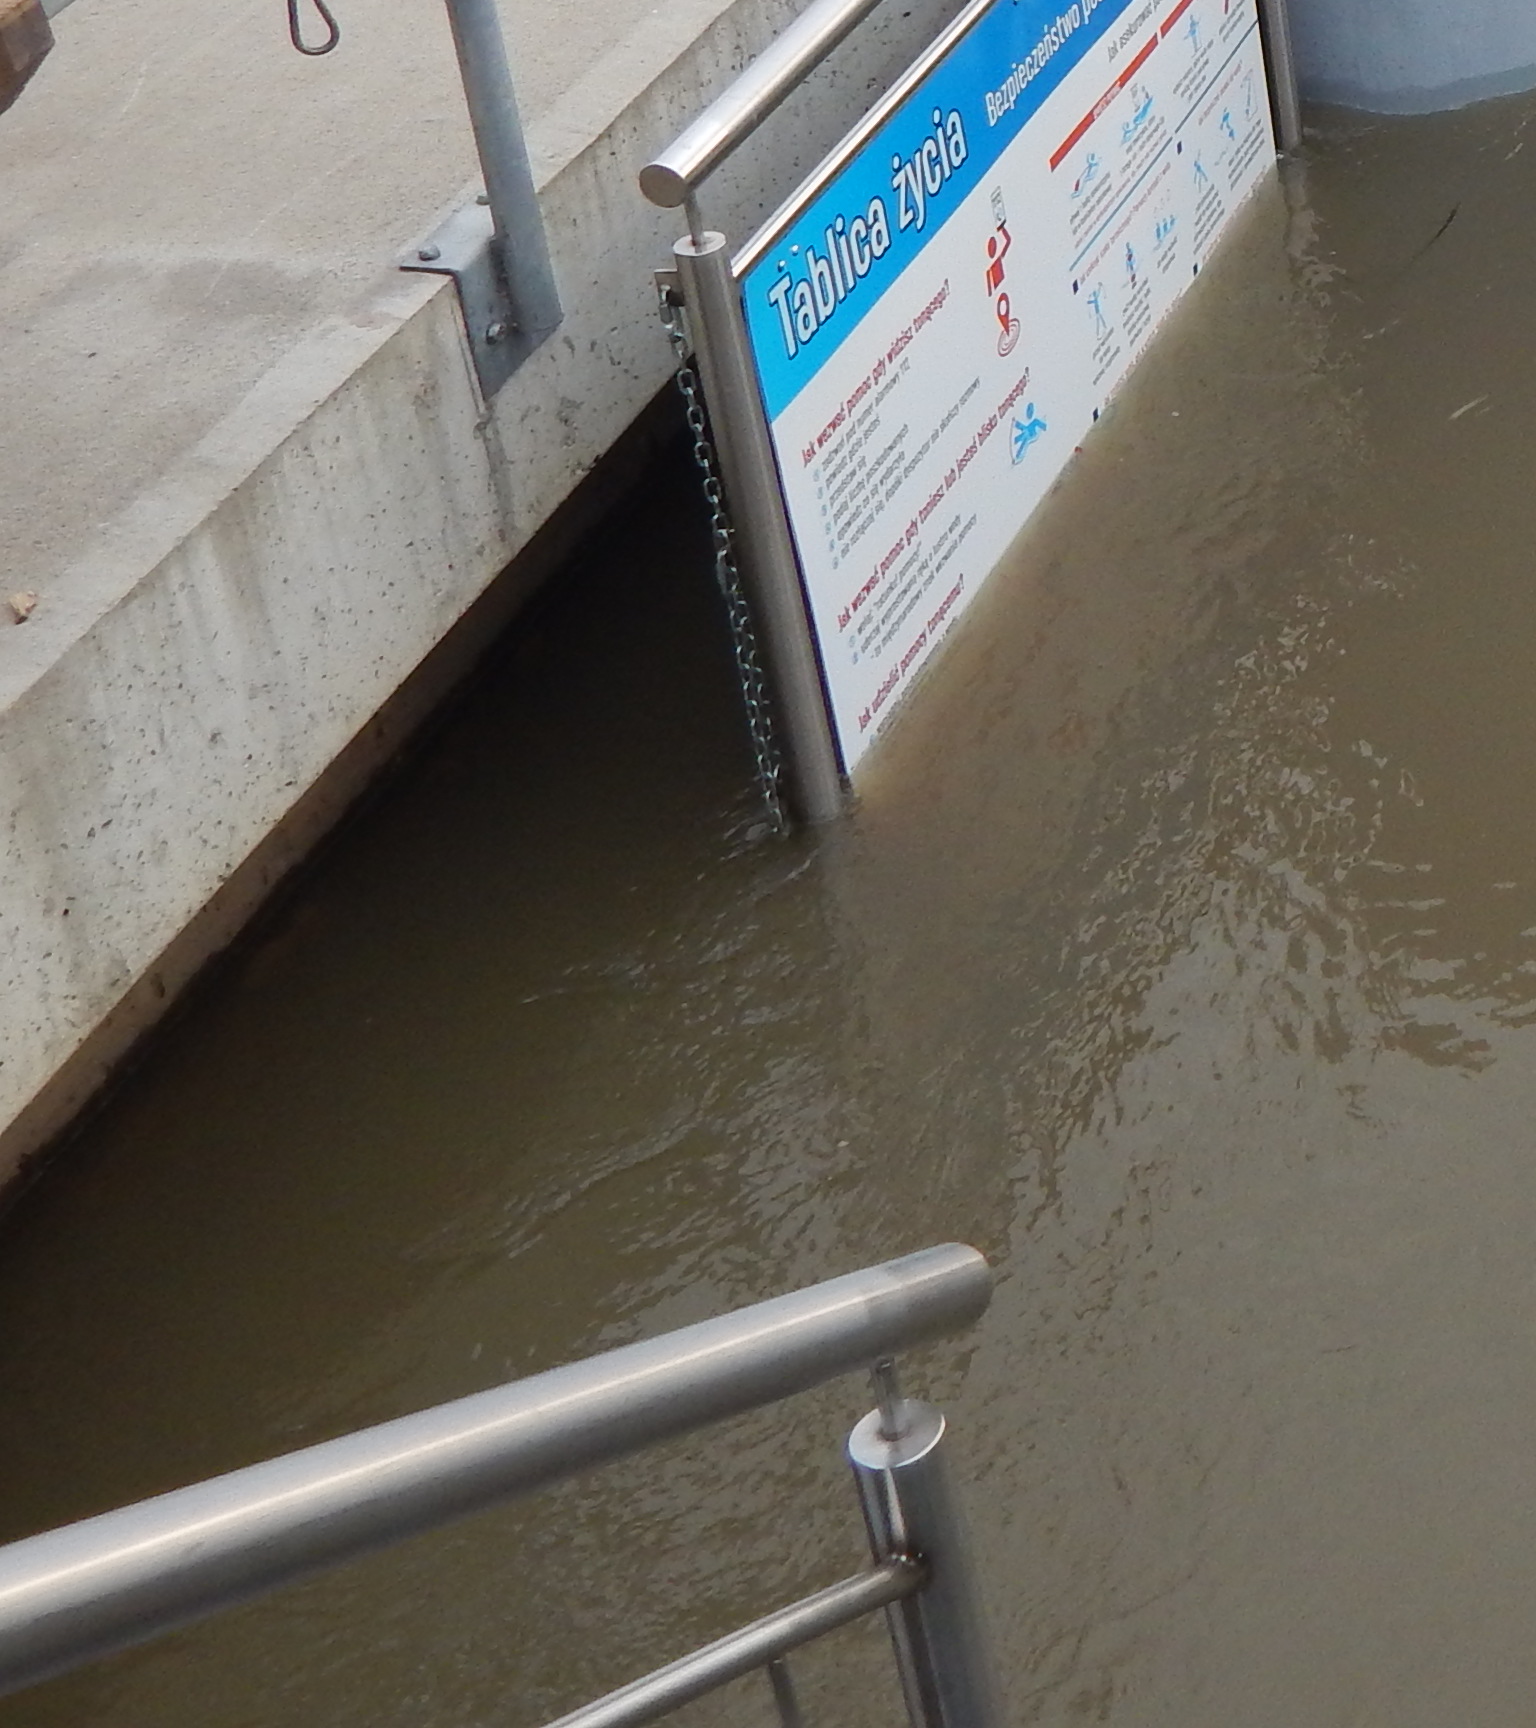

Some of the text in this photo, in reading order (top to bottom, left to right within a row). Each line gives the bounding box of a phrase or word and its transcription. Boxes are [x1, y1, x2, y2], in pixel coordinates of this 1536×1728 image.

[985, 3, 1080, 126] Bezpieczeństwo
[769, 198, 889, 354] Tablica
[892, 110, 966, 228] życia
